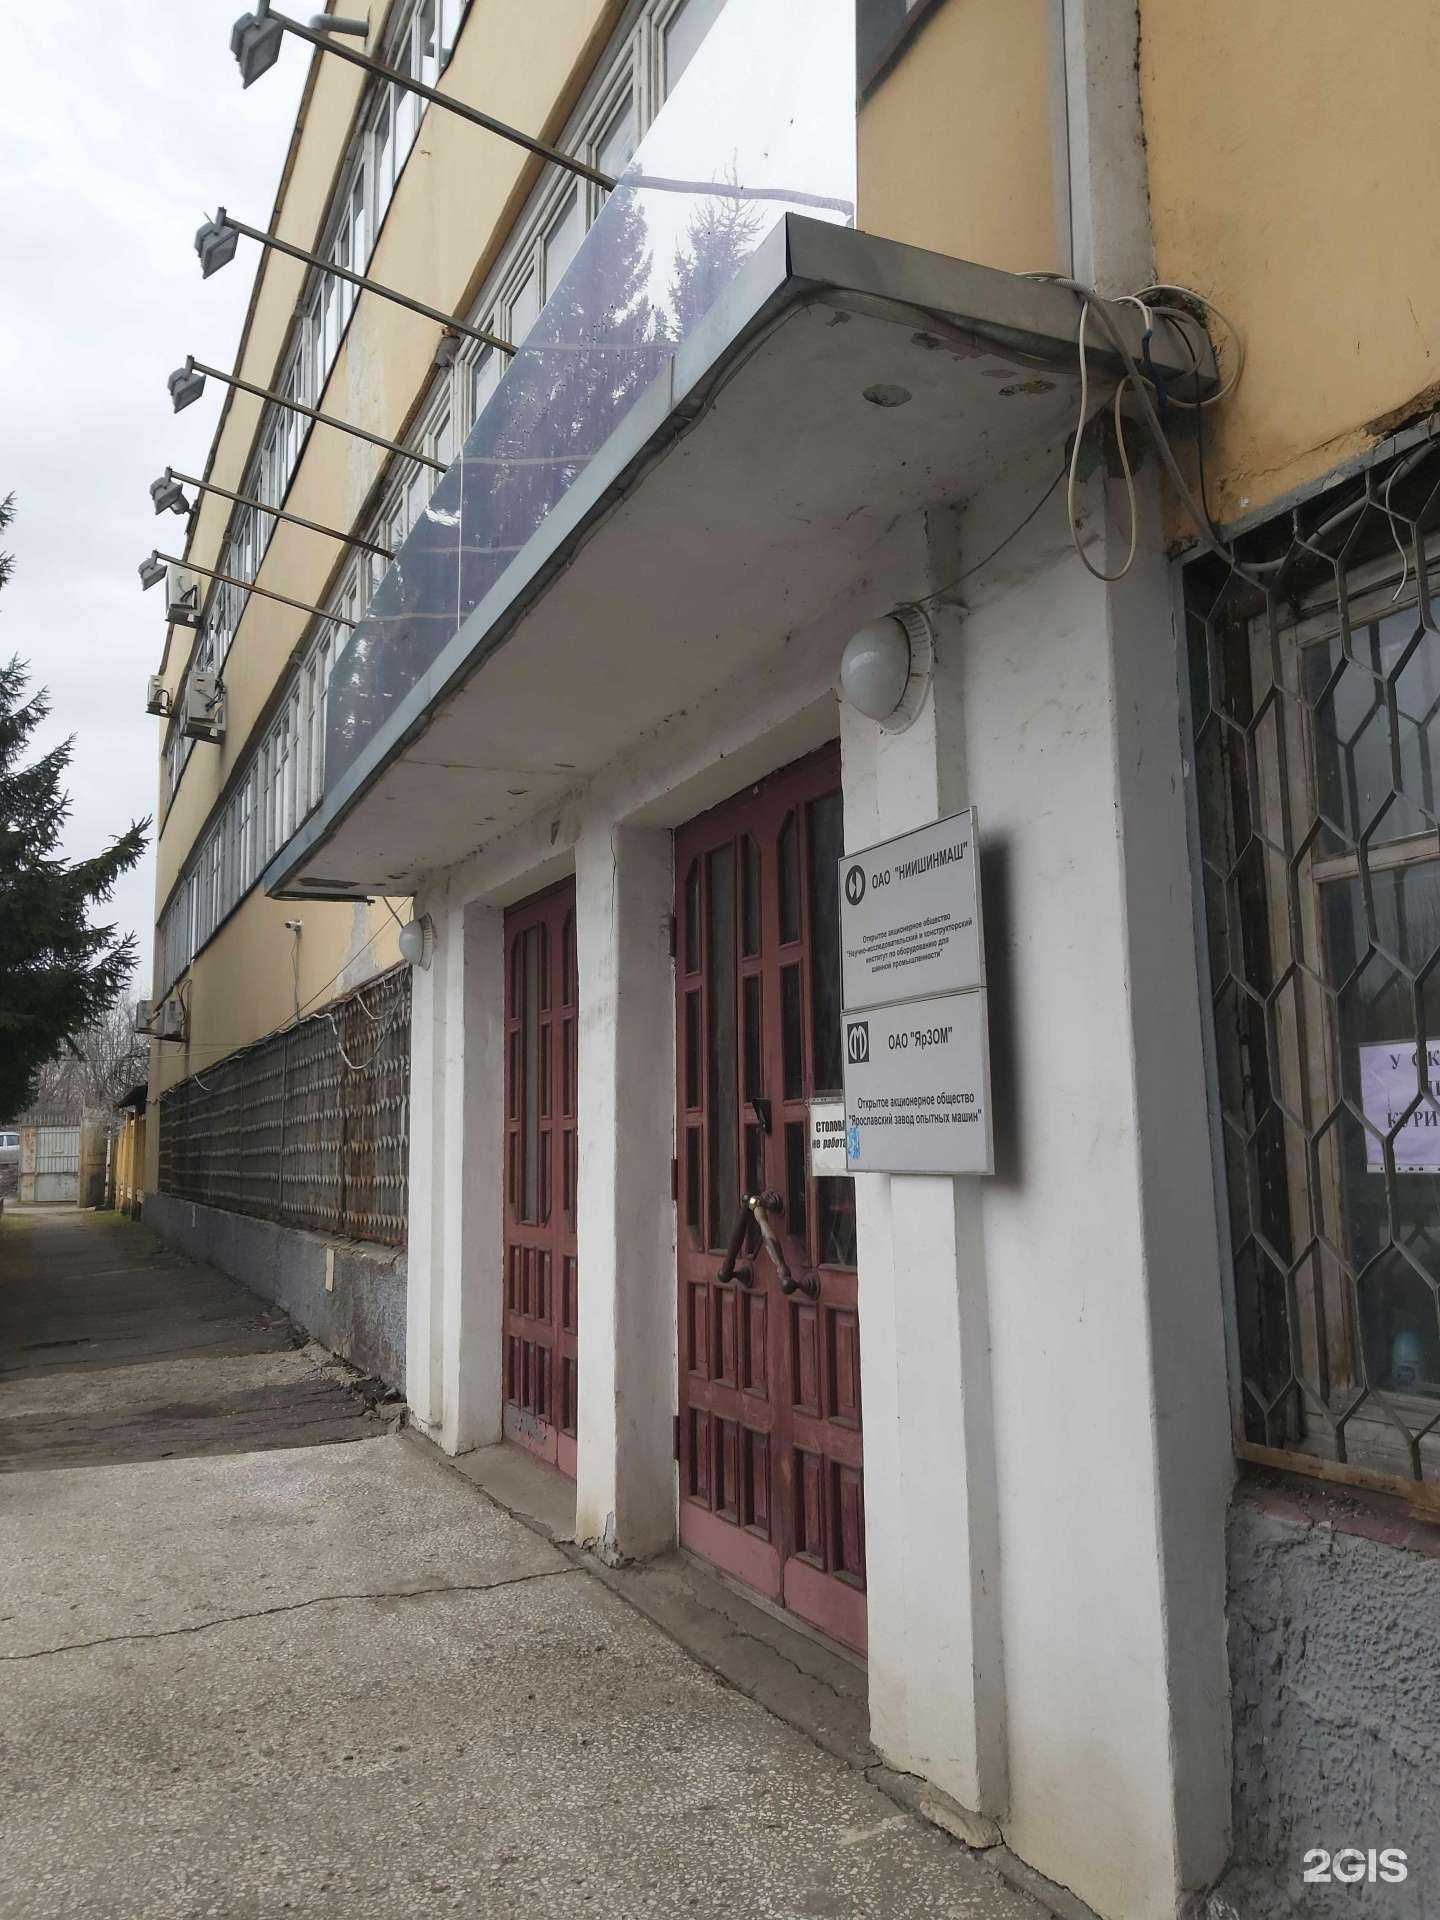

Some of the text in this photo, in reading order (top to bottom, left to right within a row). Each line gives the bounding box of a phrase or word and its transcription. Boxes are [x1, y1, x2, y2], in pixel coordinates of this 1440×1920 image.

[871, 841, 968, 889] ОАО "НИИШИНМАШ"
[862, 913, 951, 944] Открытое акционерное общество
[923, 917, 972, 939] конструкторский
[896, 939, 937, 957] оборудованию
[888, 1026, 953, 1050] ОАО "ЯрЗОМ"
[857, 1091, 975, 1111] Открытое акционерное общество
[848, 1108, 982, 1129] "Ярославский завод опытных машин"
